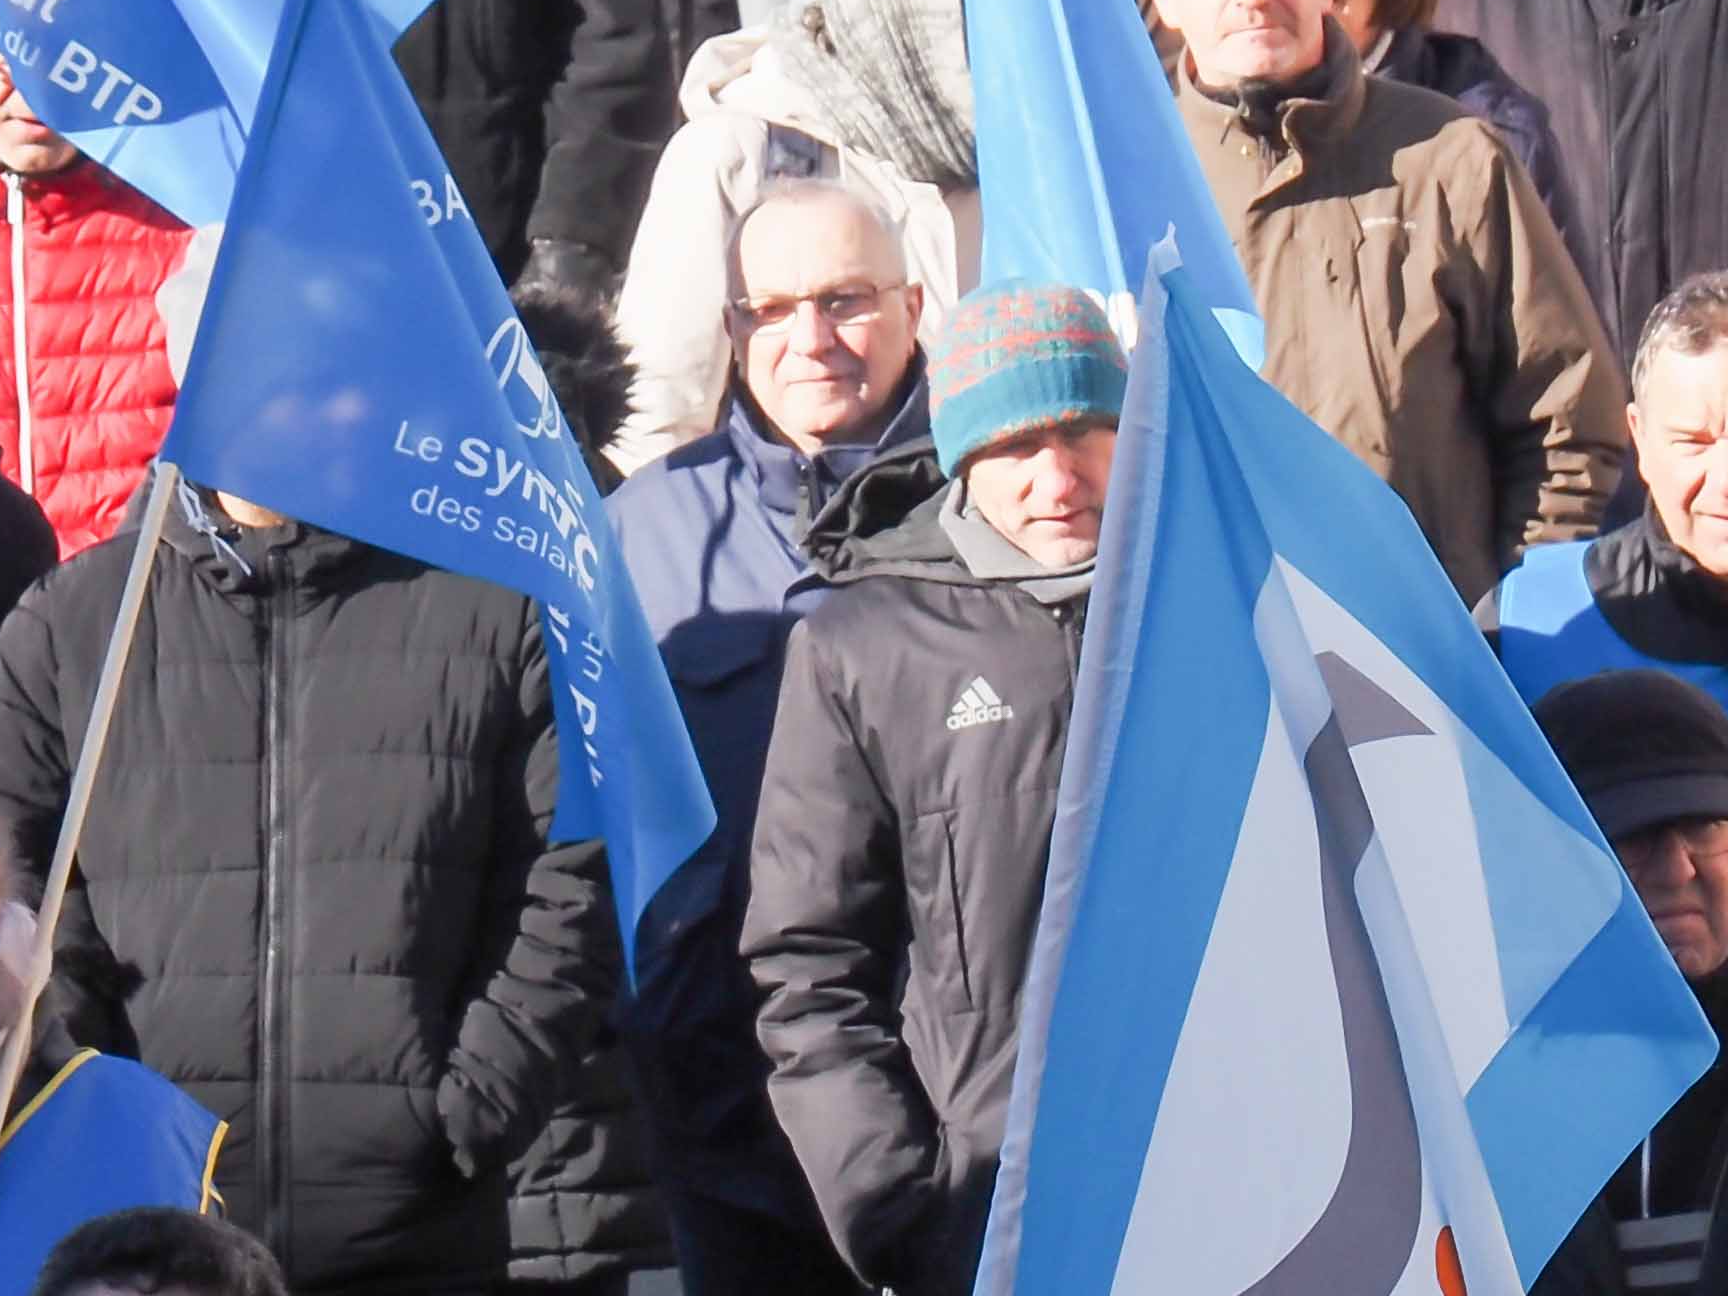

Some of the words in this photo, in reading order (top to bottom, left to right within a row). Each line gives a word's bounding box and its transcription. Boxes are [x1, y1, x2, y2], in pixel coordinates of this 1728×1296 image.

[3, 28, 42, 68] du
[47, 39, 164, 126] BTP
[393, 419, 443, 463] Le
[409, 482, 482, 533] des
[945, 704, 1014, 731] adidas
